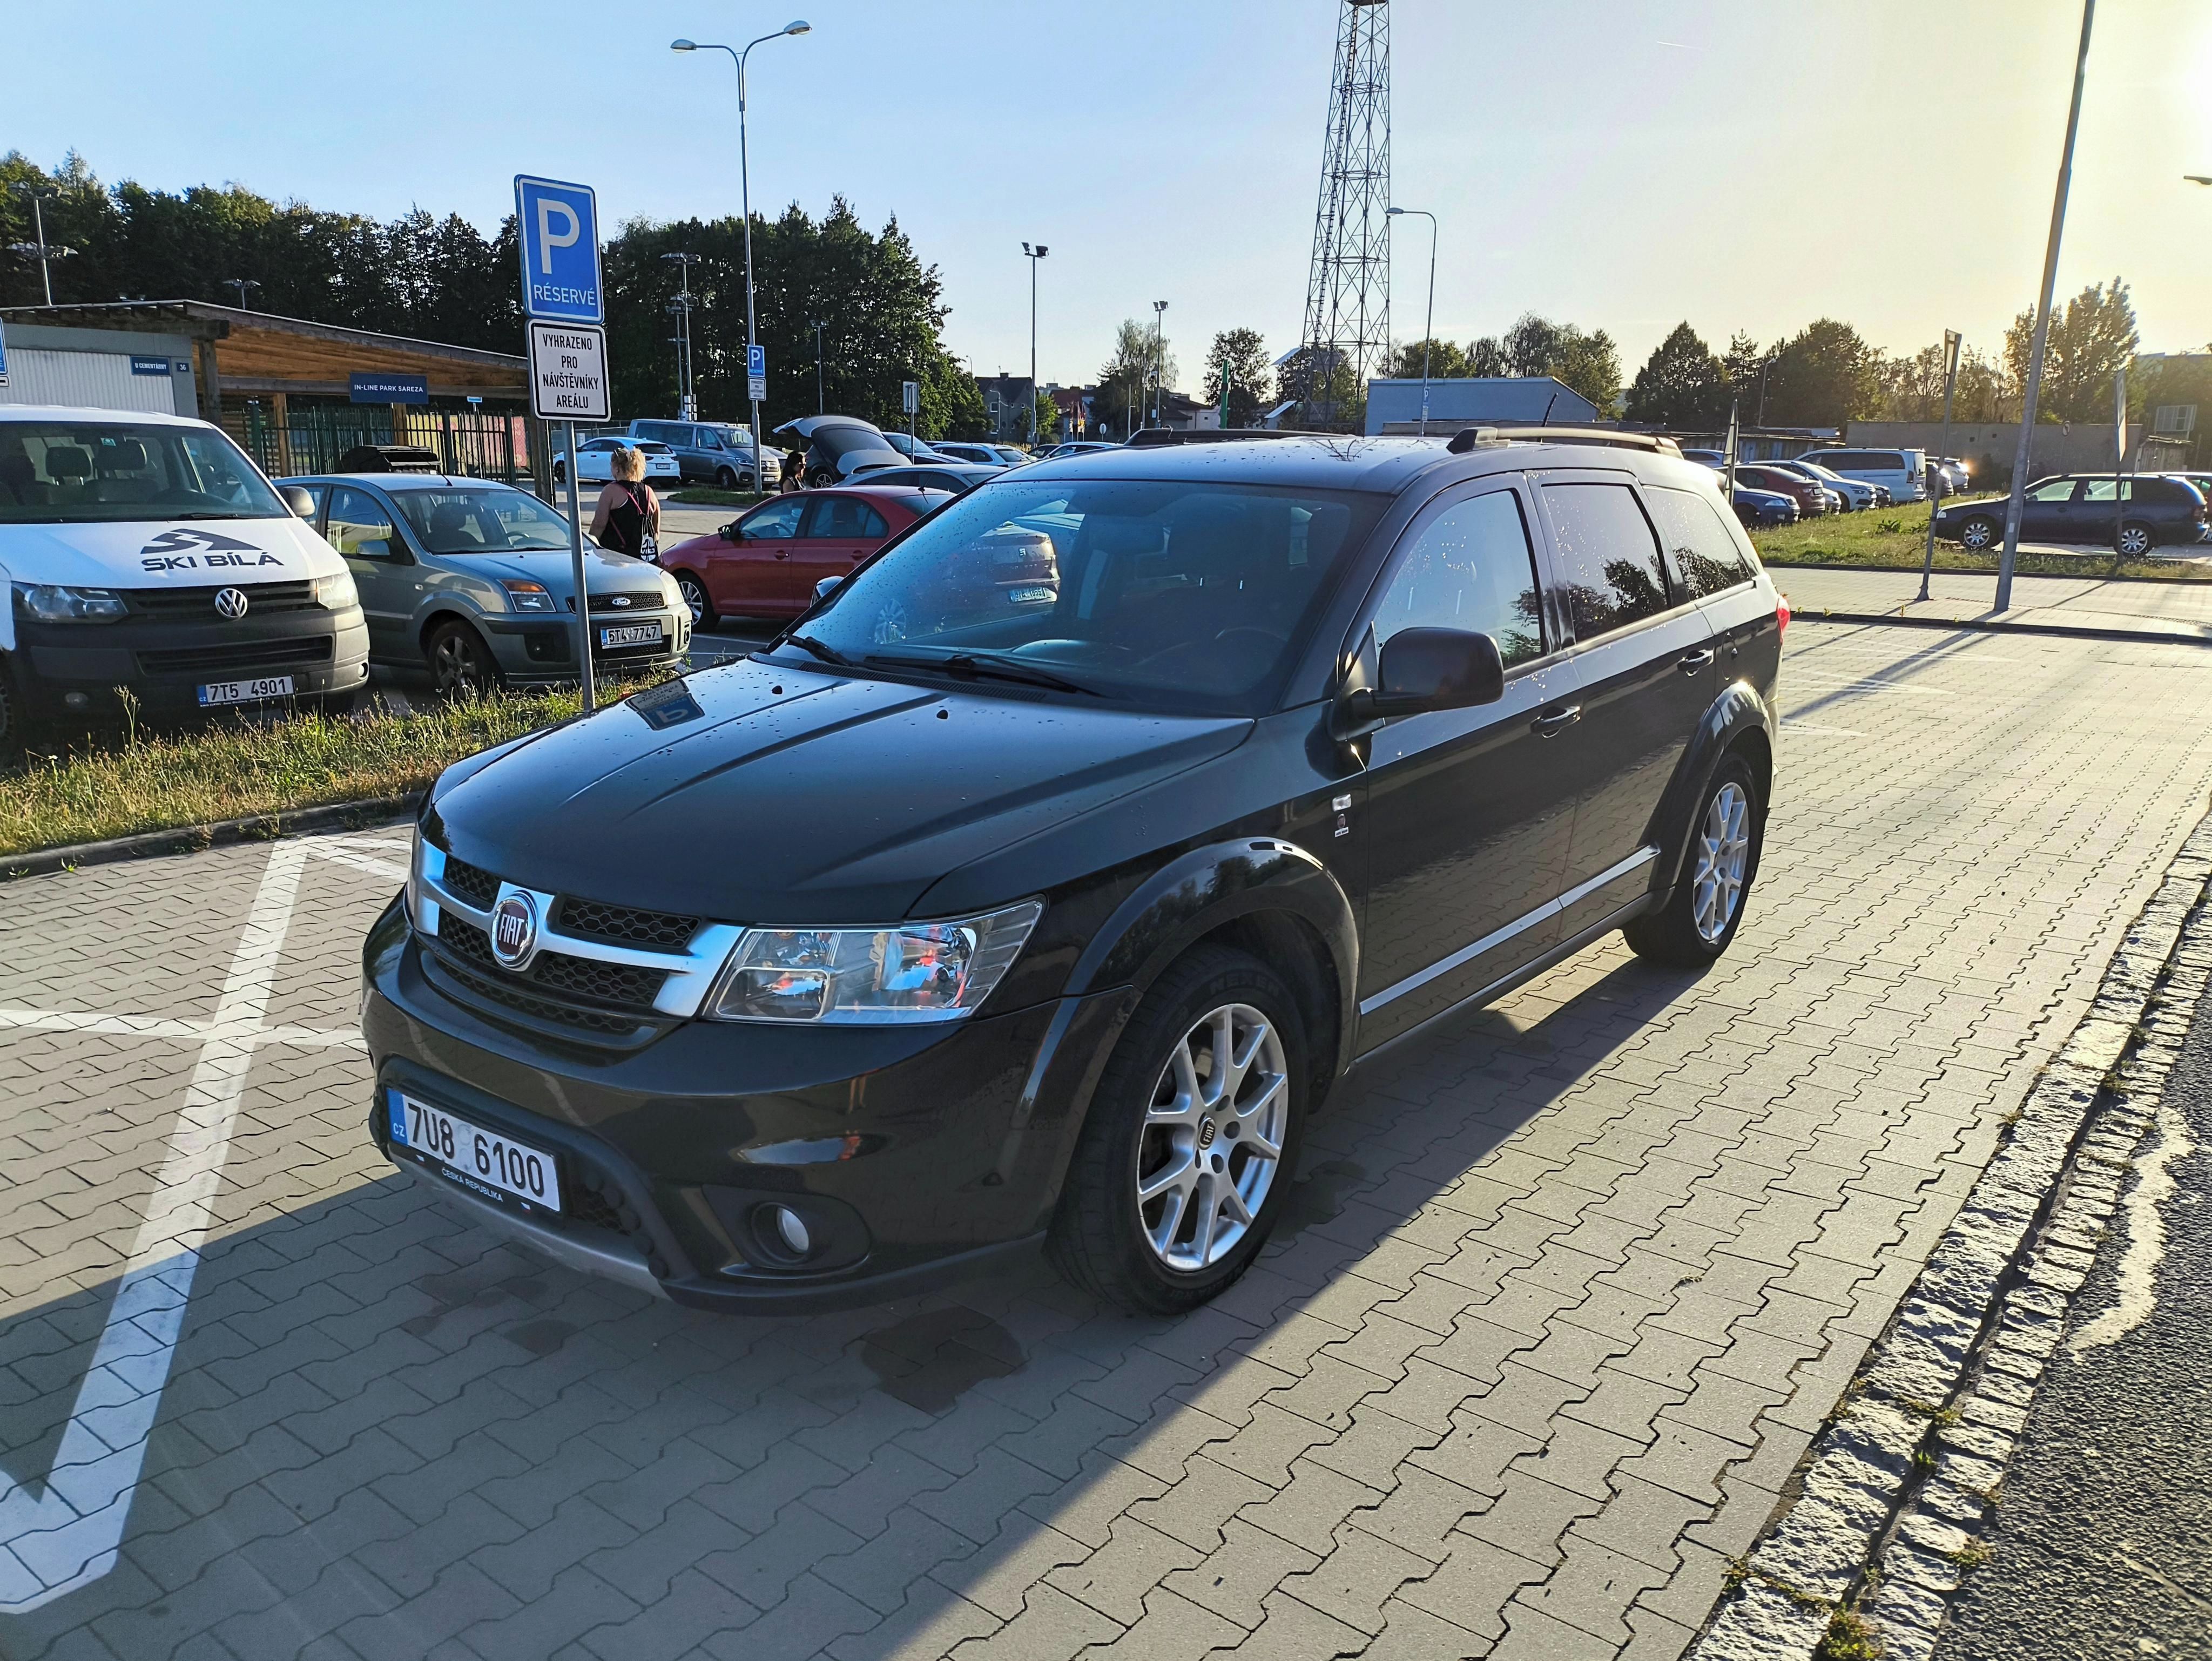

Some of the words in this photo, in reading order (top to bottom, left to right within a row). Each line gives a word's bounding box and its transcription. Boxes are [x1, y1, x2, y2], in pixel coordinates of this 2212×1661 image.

[537, 198, 581, 274] P
[534, 282, 596, 306] RÉSERVÉ
[542, 333, 592, 350] VYHRAZENO
[561, 355, 578, 369] PRO
[751, 349, 760, 367] P
[542, 371, 599, 390] NÁVŠTĚVNÍKY
[556, 392, 589, 409] AREÁLU
[141, 556, 198, 571] SKI
[204, 551, 285, 566] BÍLÁ
[609, 629, 627, 642] 5T4
[634, 626, 657, 640] 7747
[210, 683, 239, 701] 7T5
[251, 679, 286, 696] 4901
[498, 914, 524, 946] FIAT
[393, 1123, 405, 1138] CZ
[1203, 1123, 1215, 1143] FIAT
[408, 1103, 455, 1159] 7U8
[474, 1133, 544, 1198] 6100
[465, 1179, 503, 1203] REPUBLIKA
